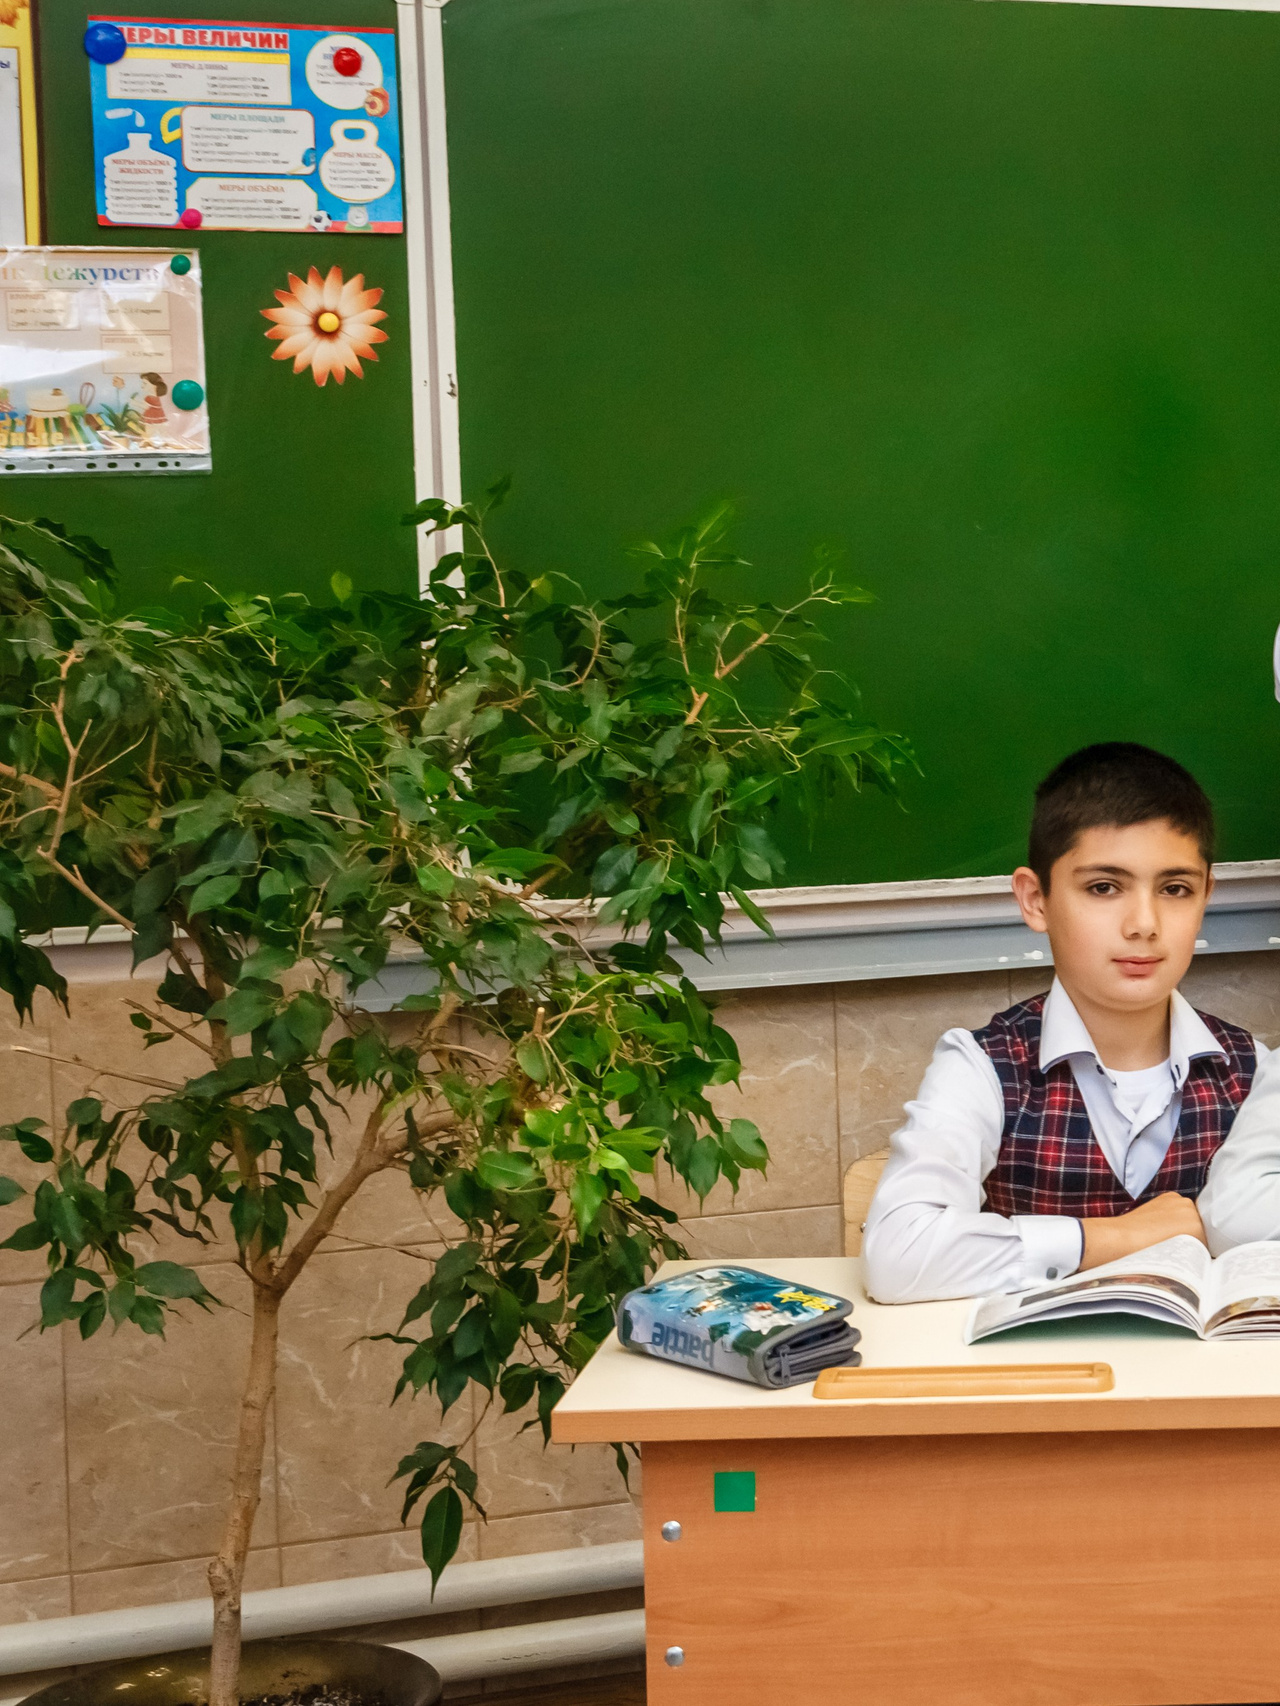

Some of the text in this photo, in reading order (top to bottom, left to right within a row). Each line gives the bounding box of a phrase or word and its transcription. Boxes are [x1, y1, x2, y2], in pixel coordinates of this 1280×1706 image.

[117, 26, 289, 50] ЕРЫ ВЕЛИЧИН
[210, 113, 237, 121] МЕРЫ
[652, 1322, 715, 1368] battle
